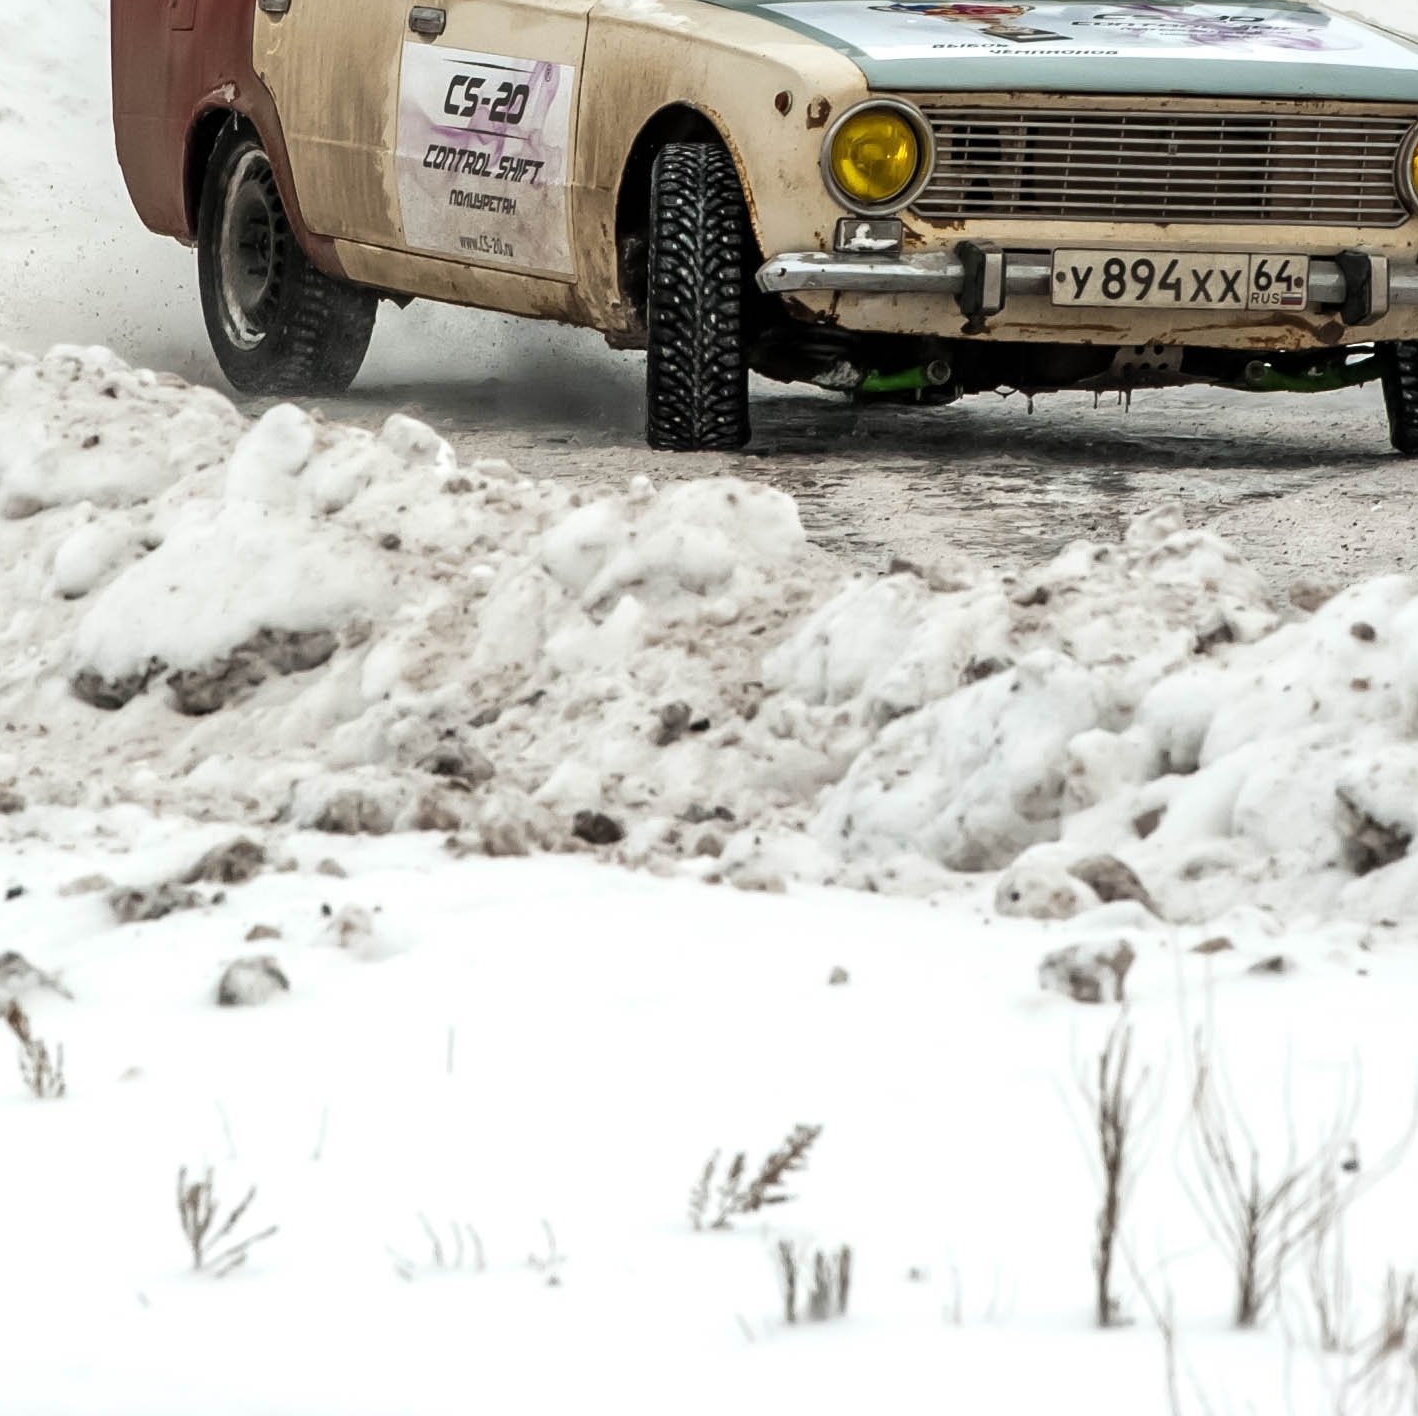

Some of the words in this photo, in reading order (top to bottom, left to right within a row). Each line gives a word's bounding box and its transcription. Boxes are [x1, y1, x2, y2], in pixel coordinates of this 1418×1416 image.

[443, 74, 531, 125] CS-20
[422, 144, 493, 177] CONTROL
[493, 155, 545, 185] SHIFT
[449, 189, 517, 216] ПОЛИУРЕТАН
[1253, 259, 1294, 292] 64
[1250, 292, 1280, 305] RUS
